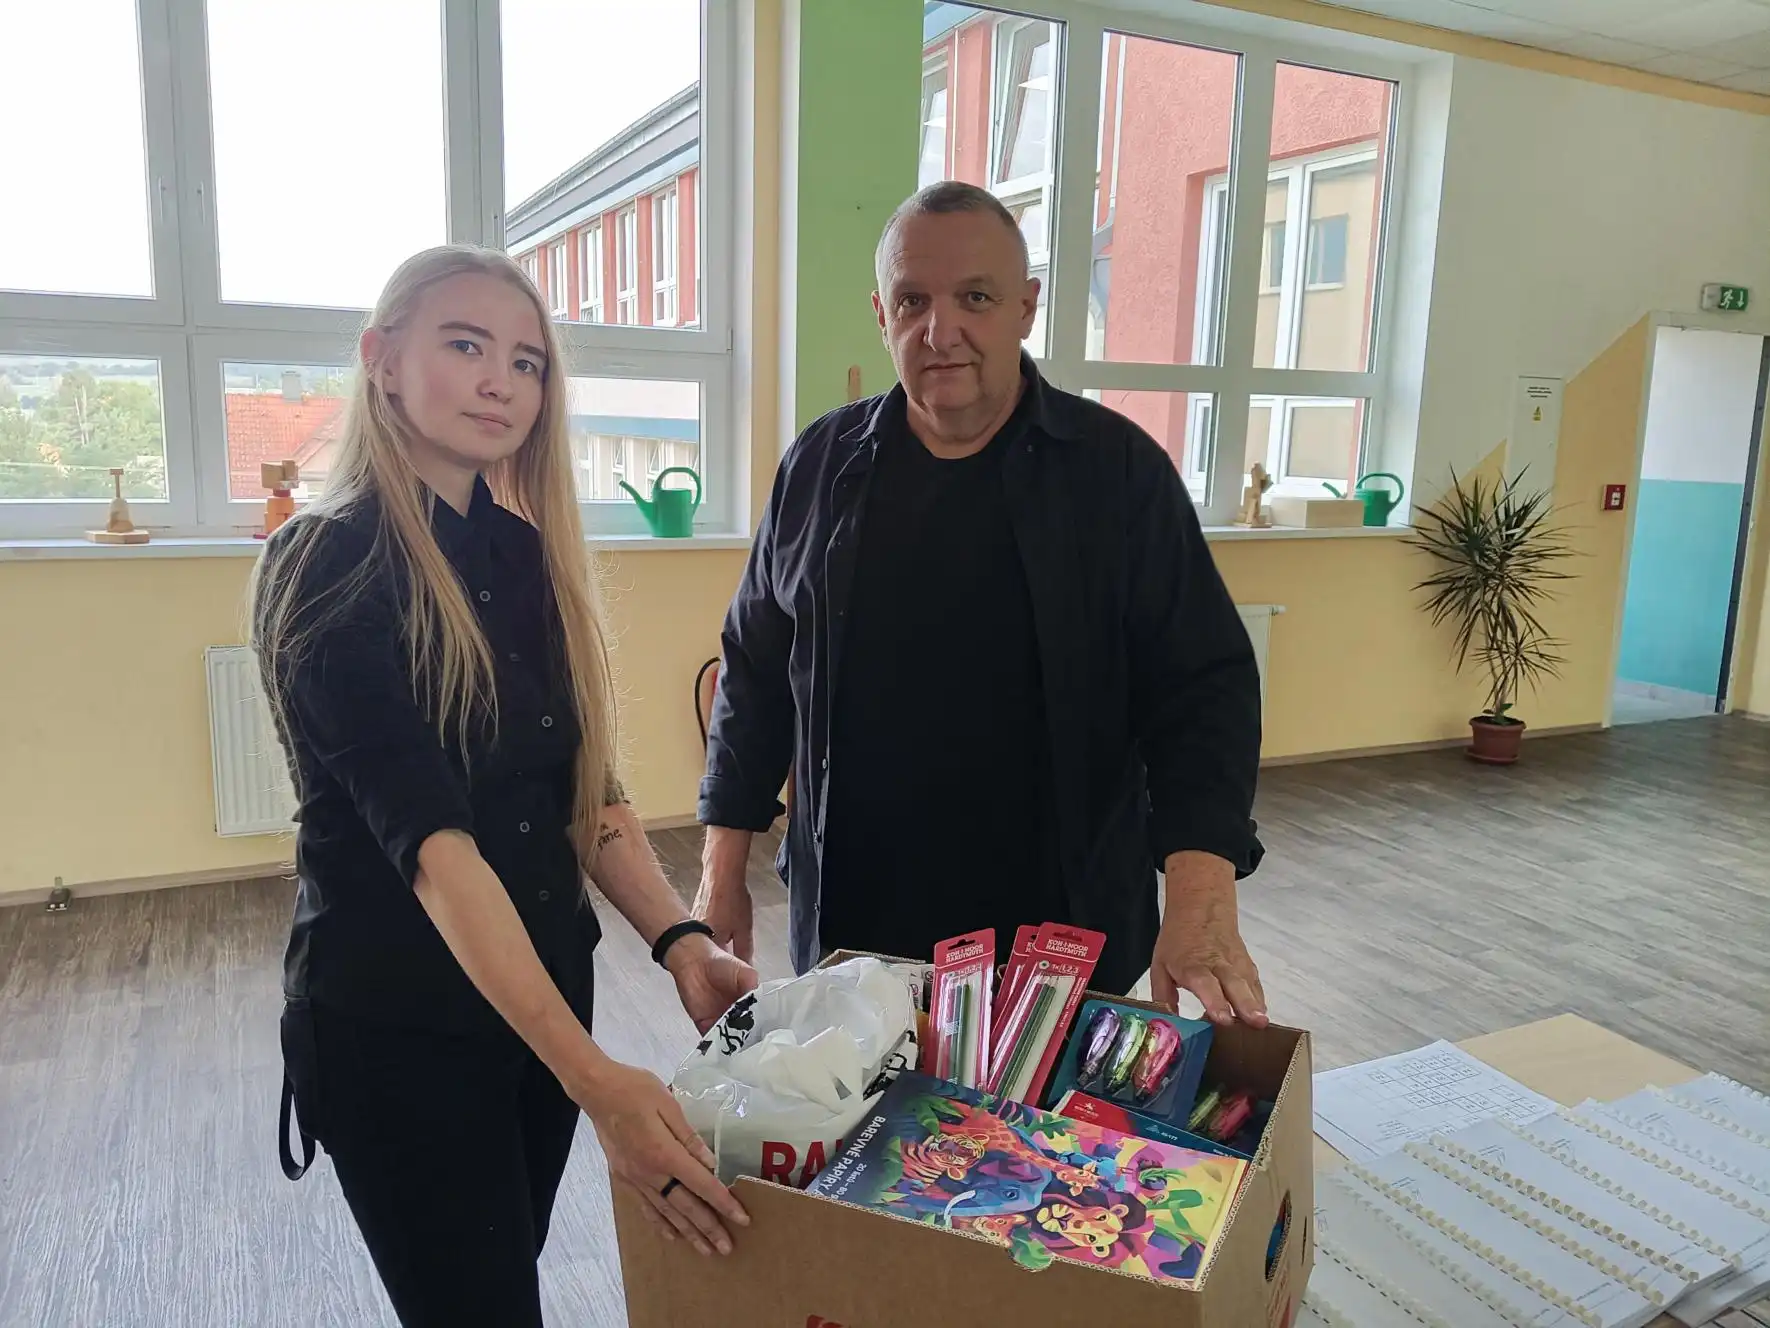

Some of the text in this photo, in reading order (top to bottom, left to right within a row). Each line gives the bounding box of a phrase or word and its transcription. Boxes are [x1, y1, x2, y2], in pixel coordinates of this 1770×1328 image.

[846, 1115, 886, 1158] BAREVNÉ
[761, 1138, 843, 1188] RA
[819, 1157, 854, 1191] PAPÍRY
[856, 1162, 867, 1172] 20
[837, 1186, 848, 1196] 80
